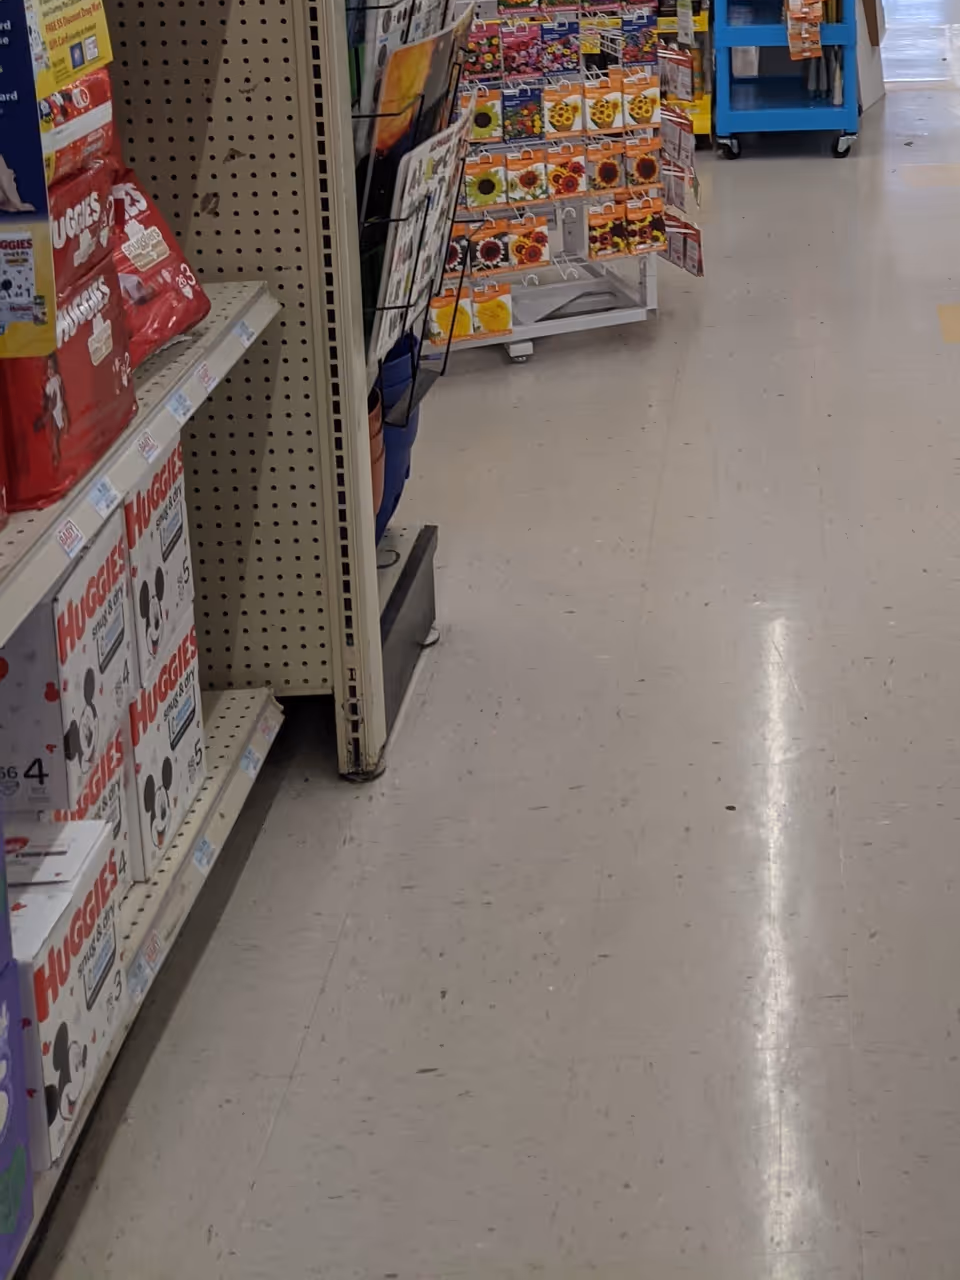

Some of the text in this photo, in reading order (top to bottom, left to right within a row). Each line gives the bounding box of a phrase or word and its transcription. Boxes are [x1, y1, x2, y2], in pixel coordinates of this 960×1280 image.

[45, 21, 58, 34] FREE
[63, 11, 82, 28] Discount
[81, 6, 93, 23] Drug
[180, 263, 197, 286] 3
[55, 275, 111, 348] HUGGIES
[125, 440, 185, 550] HUGGIES
[59, 525, 76, 545] BABY
[156, 507, 169, 531] snug
[182, 555, 191, 585] 5
[57, 534, 127, 666] HUGGIES
[92, 611, 108, 641] snug
[112, 581, 125, 608] dry
[121, 658, 129, 685] 4
[129, 623, 198, 748] HUGGIES
[163, 689, 179, 722] snug
[183, 666, 195, 688] dry
[194, 737, 203, 767] 5
[23, 758, 49, 786] 4
[118, 848, 128, 876] 4
[34, 848, 119, 1022] HUGGIES
[77, 935, 97, 979] snug
[100, 898, 115, 926] dry
[113, 968, 124, 1004] 3
